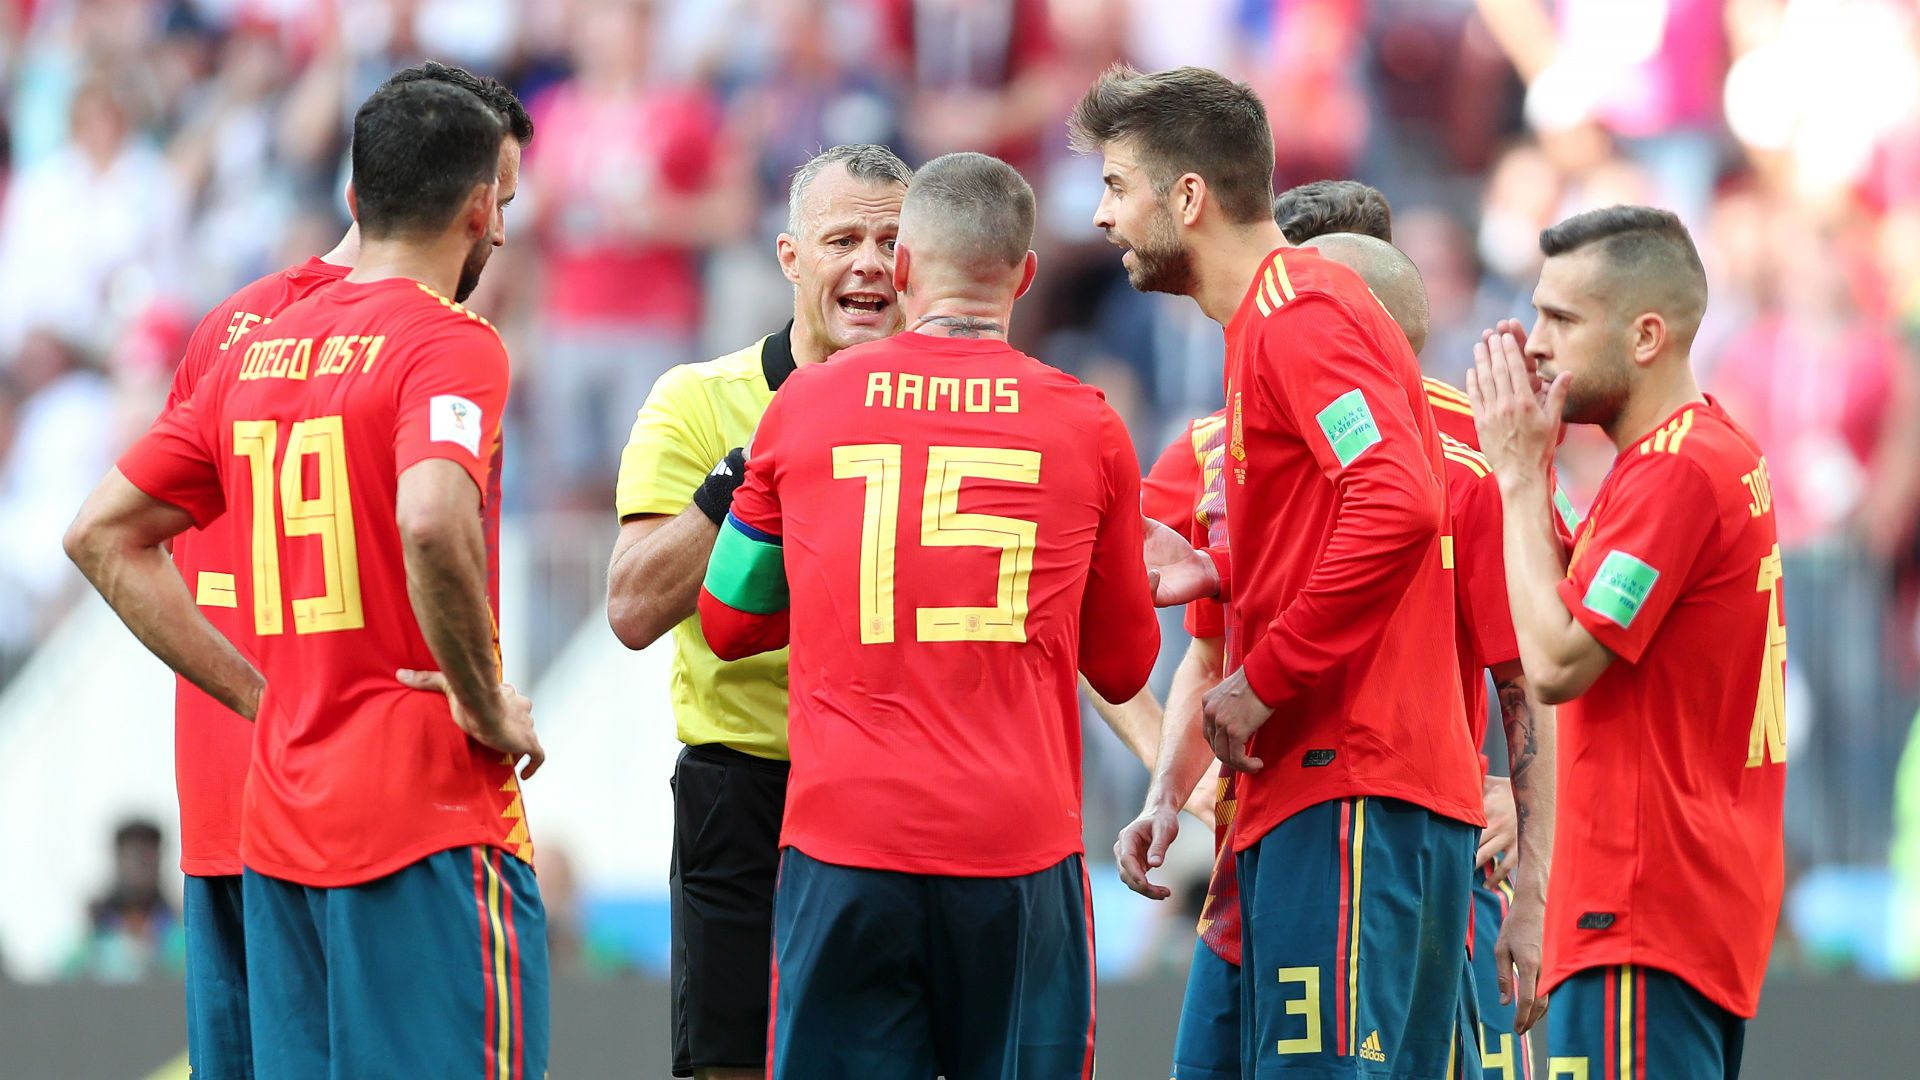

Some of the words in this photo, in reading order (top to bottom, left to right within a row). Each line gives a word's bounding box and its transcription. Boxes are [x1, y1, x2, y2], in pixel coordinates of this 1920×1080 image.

[219, 311, 273, 351] SE
[238, 338, 314, 381] DIEGO
[864, 372, 1019, 413] RAMOS
[1354, 422, 1371, 436] FIFA
[1741, 455, 1771, 518] JO
[233, 415, 365, 636] 19
[832, 444, 1042, 645] 15
[1277, 966, 1322, 1055] 3
[1359, 1048, 1386, 1063] adidas
